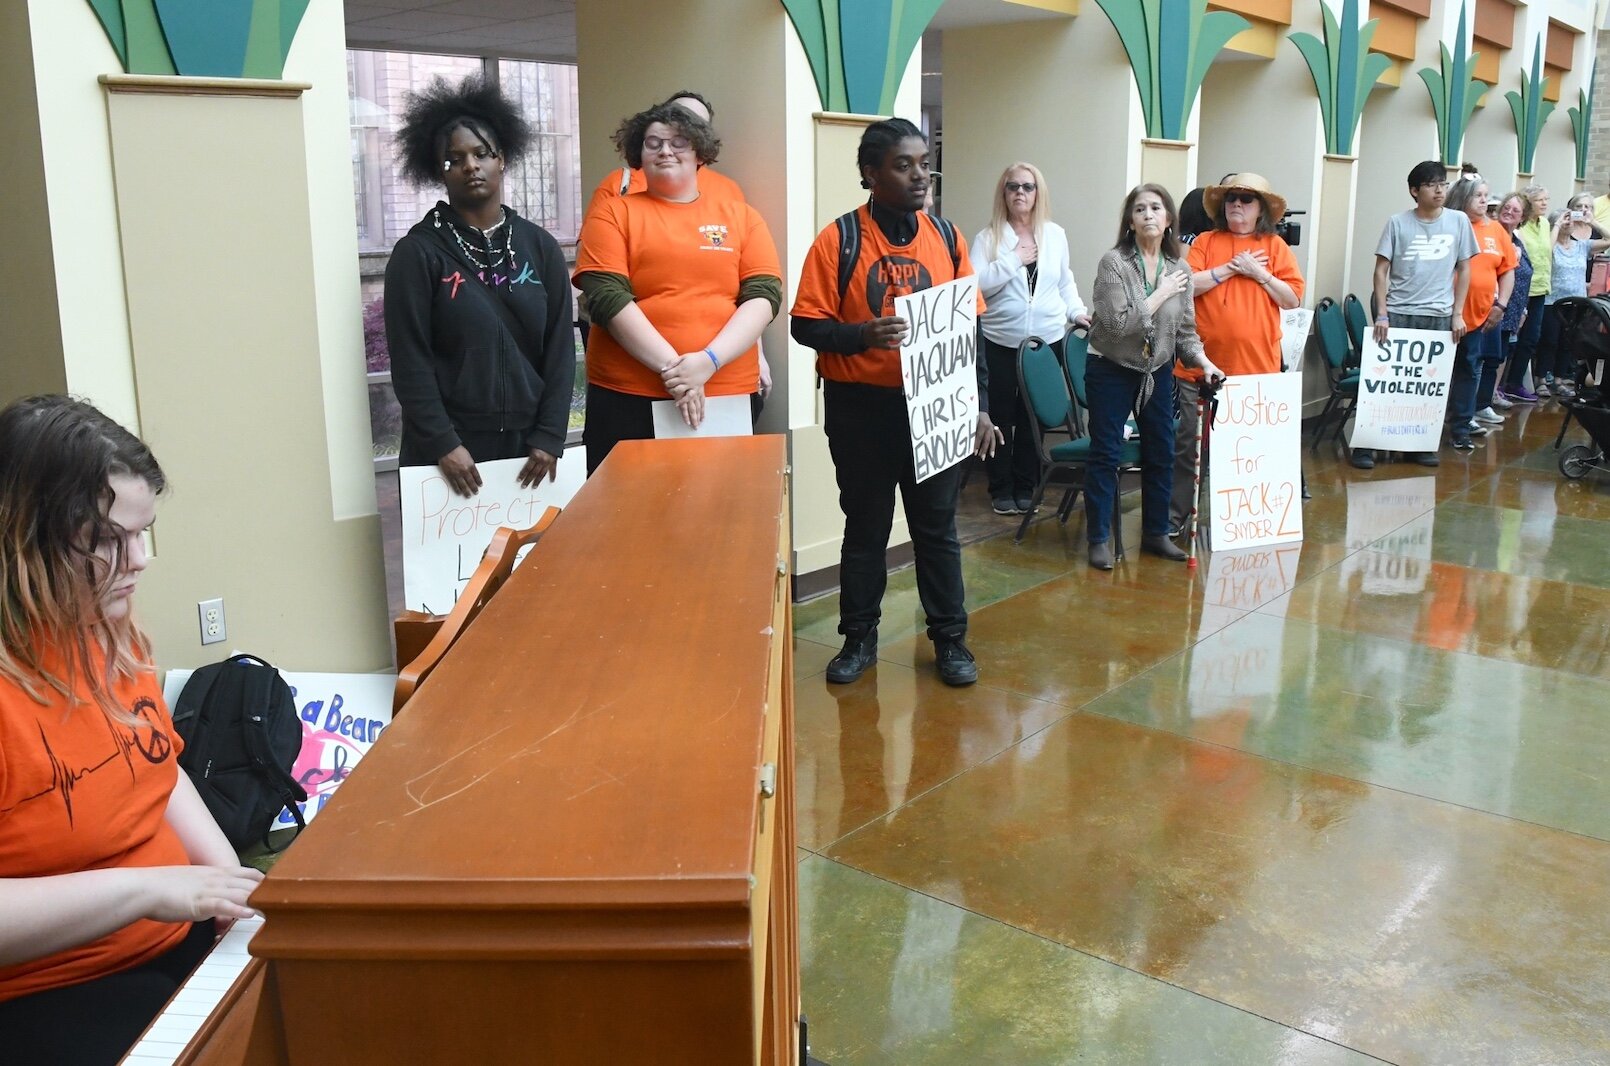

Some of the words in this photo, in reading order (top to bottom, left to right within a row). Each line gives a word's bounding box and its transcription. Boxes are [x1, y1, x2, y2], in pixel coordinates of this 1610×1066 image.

[902, 284, 972, 348] JACK
[907, 326, 976, 401] JAQUAN
[1377, 338, 1445, 364] STOP
[1364, 378, 1446, 397] VIOLENCE
[1391, 365, 1423, 378] THE
[911, 386, 968, 441] CHRIS
[915, 418, 978, 480] ENOUGH
[1230, 436, 1266, 475] for
[421, 476, 541, 546] Protect
[1217, 482, 1273, 521] JACK
[1223, 519, 1273, 543] SNYDER
